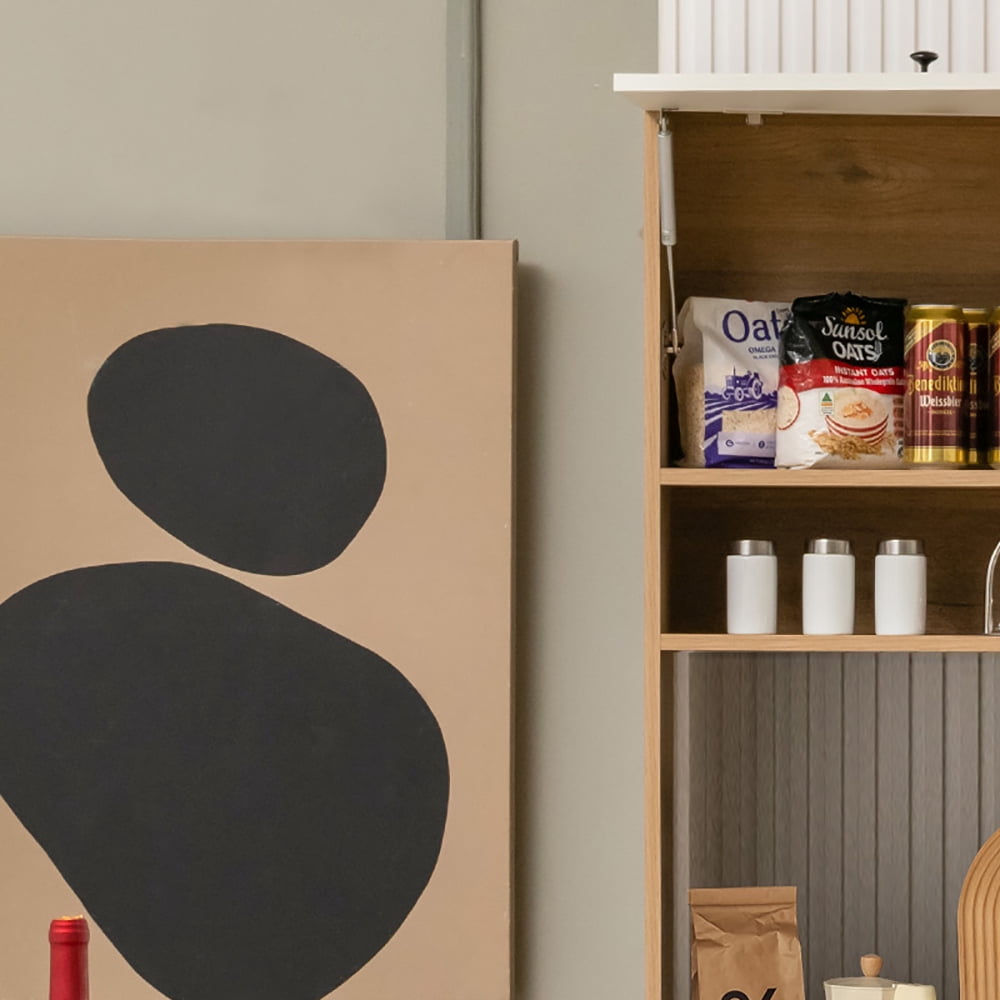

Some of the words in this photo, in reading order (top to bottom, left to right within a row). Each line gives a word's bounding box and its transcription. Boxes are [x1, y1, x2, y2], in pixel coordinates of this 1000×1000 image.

[821, 315, 888, 342] Sunsol
[832, 342, 879, 362] OATS
[834, 366, 868, 376] INSTANT
[871, 368, 895, 376] OATS
[920, 395, 962, 407] Weissbier
